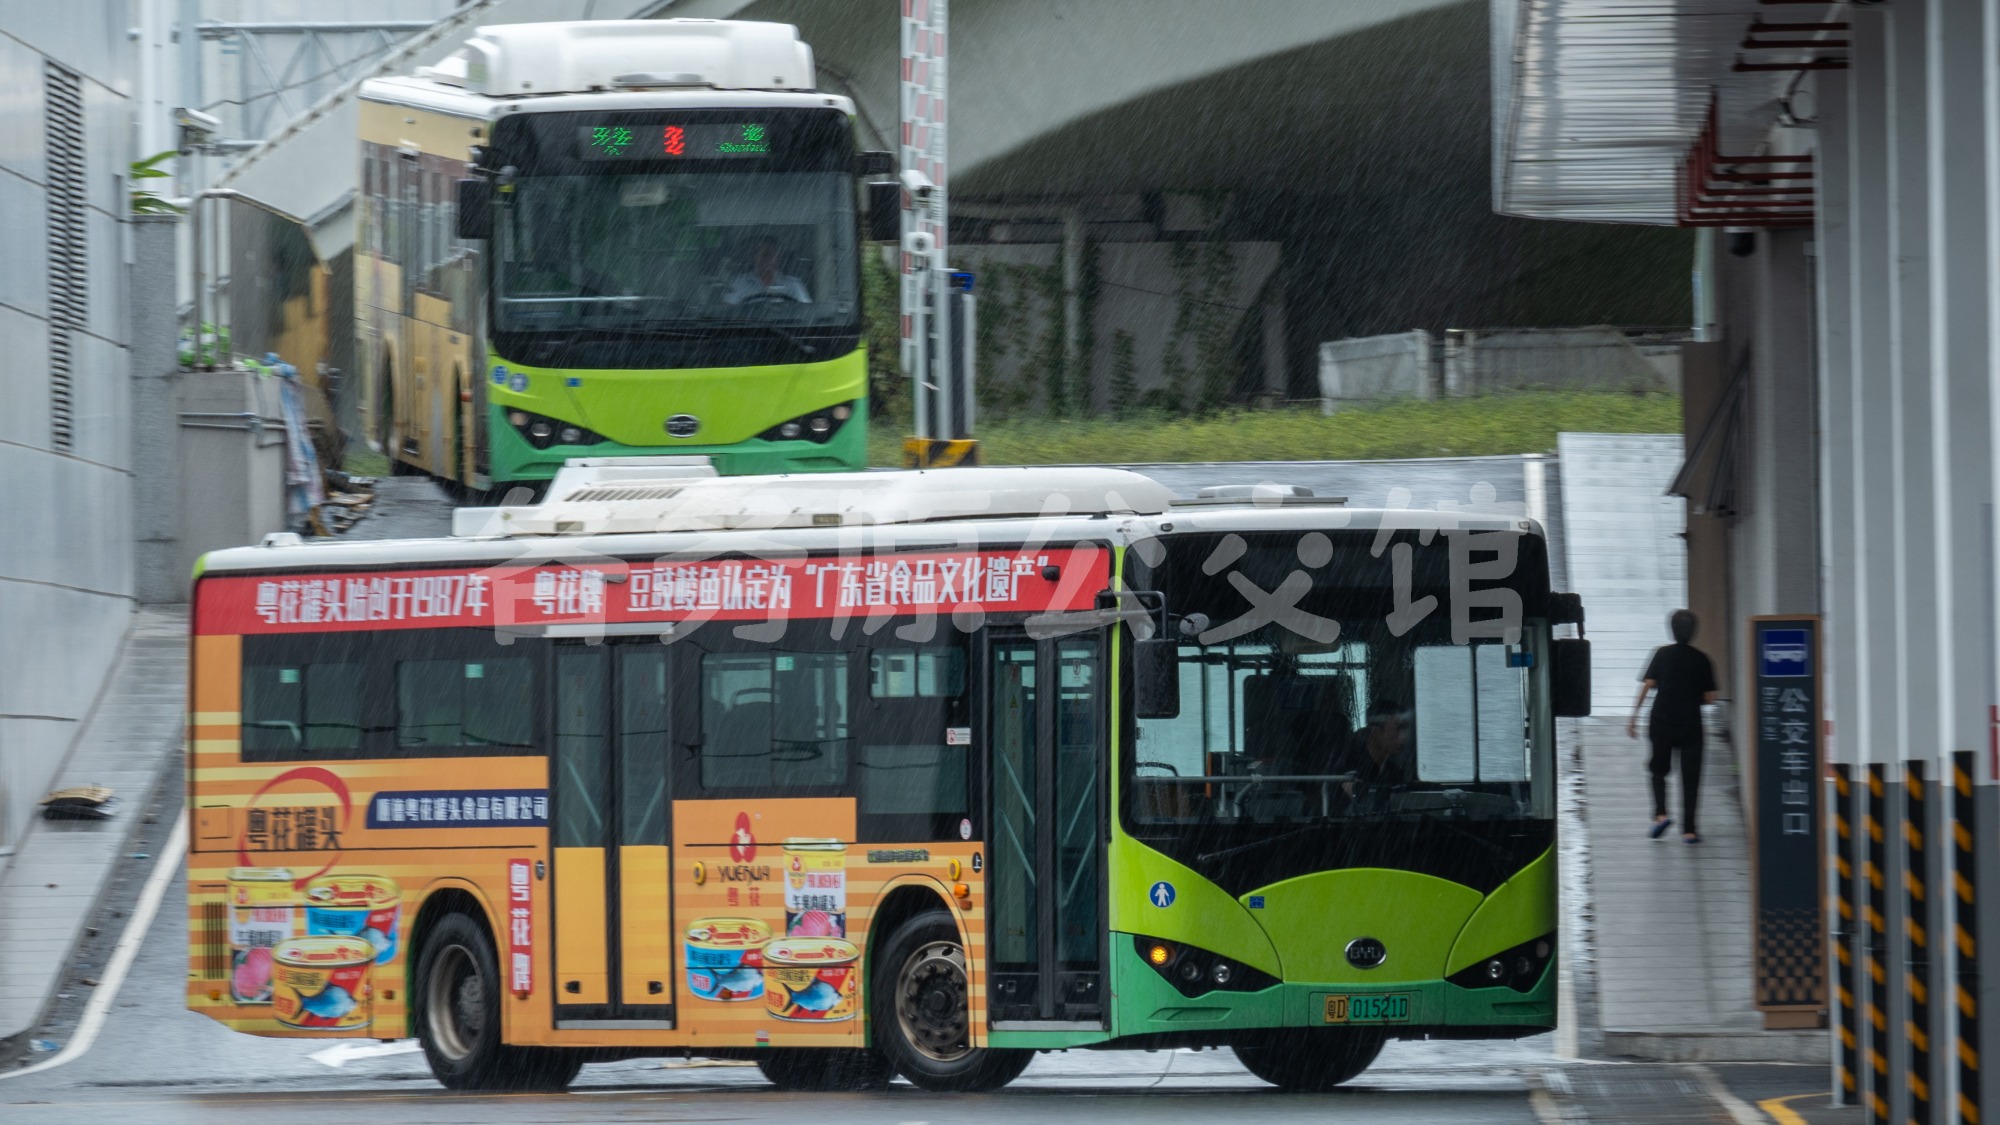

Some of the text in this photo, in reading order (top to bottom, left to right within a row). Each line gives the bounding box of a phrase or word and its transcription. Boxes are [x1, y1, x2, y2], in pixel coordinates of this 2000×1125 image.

[532, 569, 604, 615] 粤花牌
[1779, 688, 1810, 834] 公交车出口
